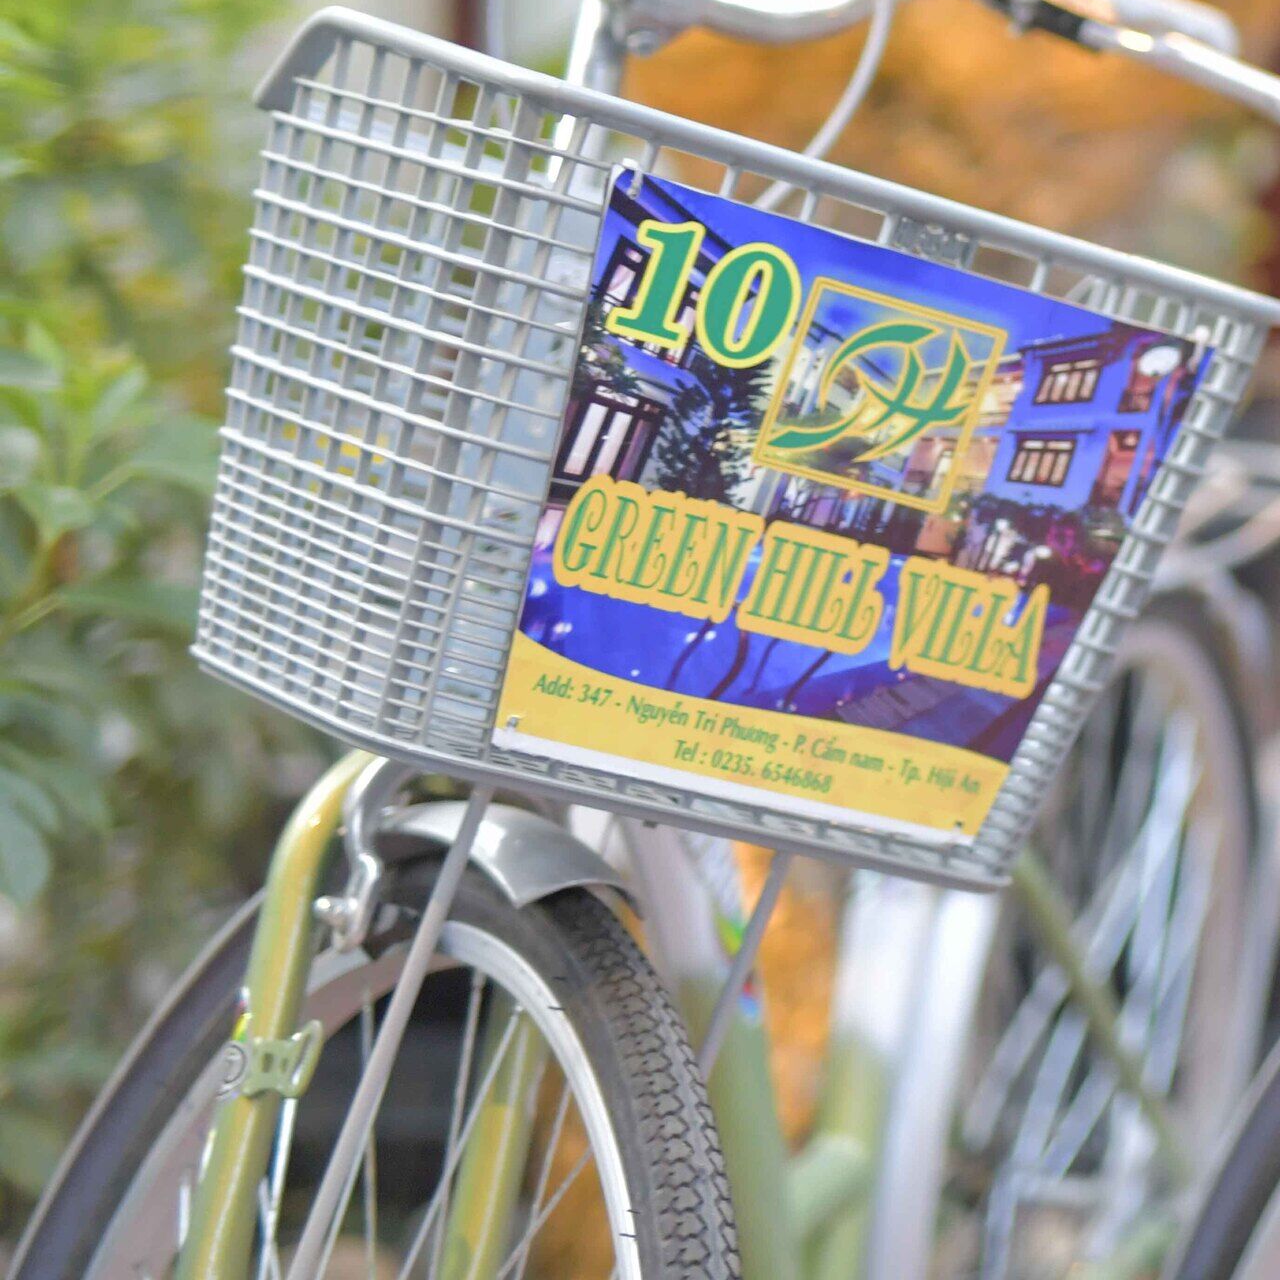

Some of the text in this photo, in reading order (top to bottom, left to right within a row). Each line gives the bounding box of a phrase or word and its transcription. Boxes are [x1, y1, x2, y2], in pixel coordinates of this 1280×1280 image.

[606, 220, 801, 368] 10
[562, 489, 1039, 683] GREEN HILL VILLA
[532, 674, 574, 699] Add:
[577, 683, 613, 707] 347
[760, 760, 833, 794] 6546868
